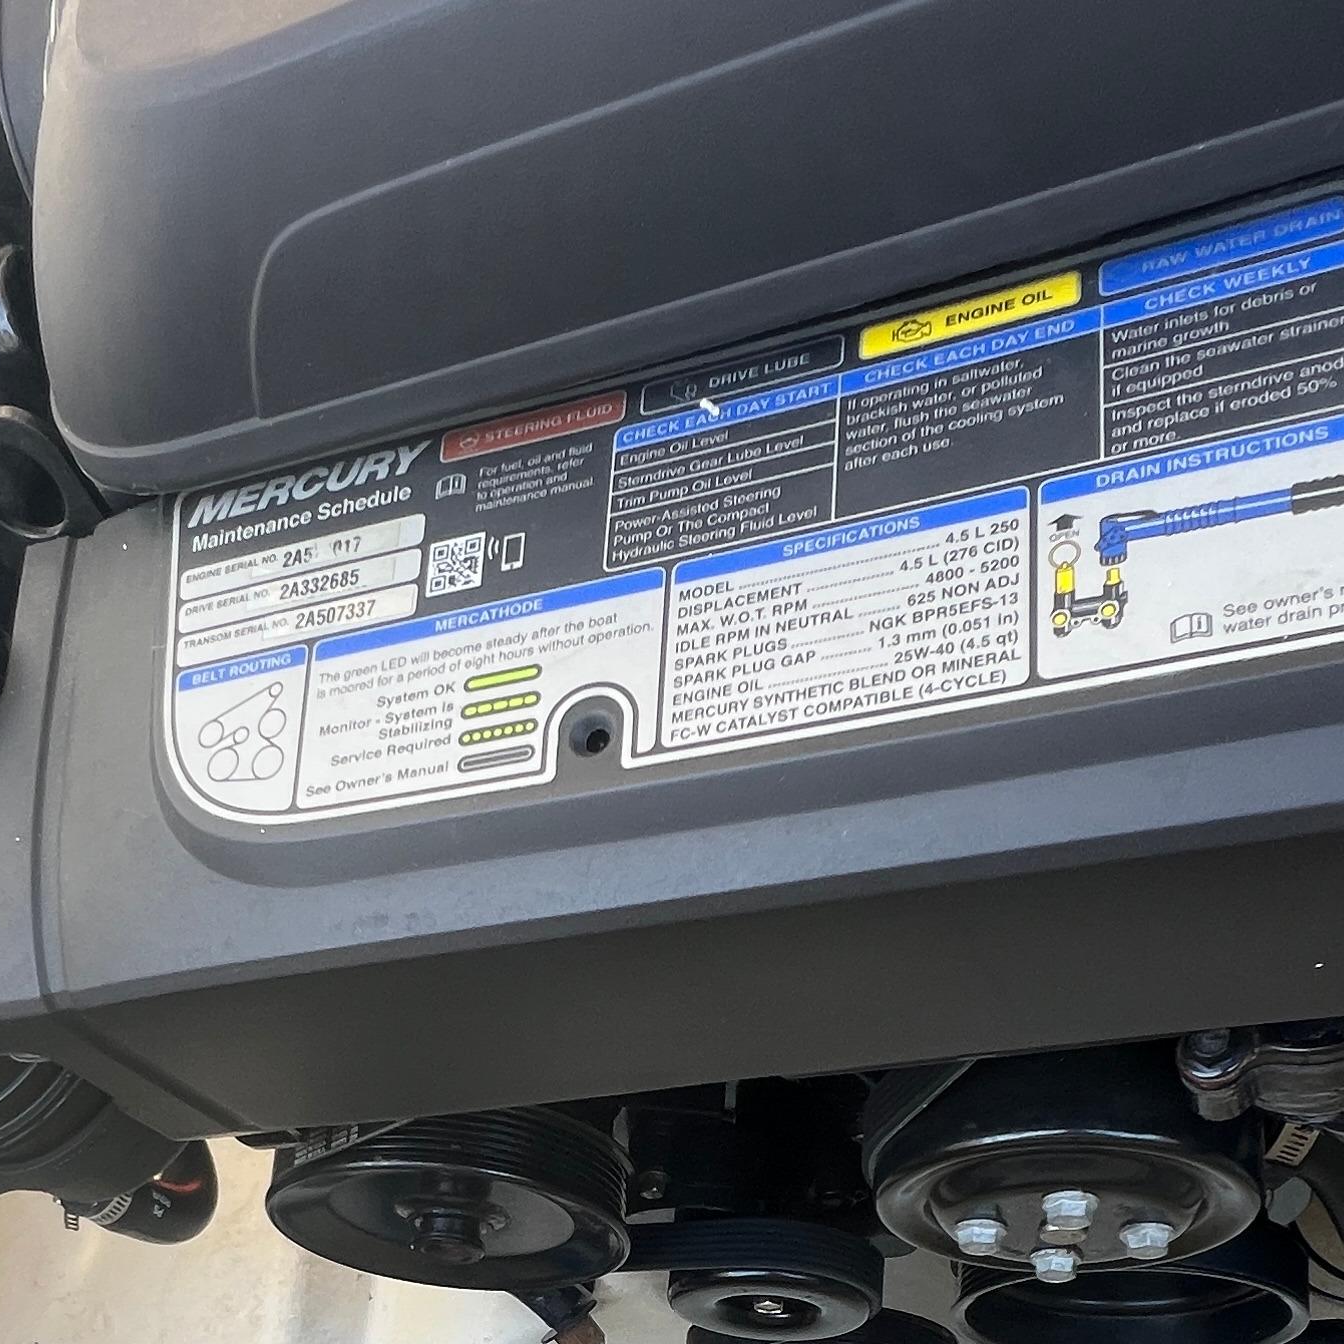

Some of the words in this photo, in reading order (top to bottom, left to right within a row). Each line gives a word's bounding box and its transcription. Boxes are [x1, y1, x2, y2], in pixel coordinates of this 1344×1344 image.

[1195, 230, 1265, 257] WATER
[1273, 209, 1340, 236] DRAIN
[945, 297, 1015, 326] ENGINE
[1021, 289, 1052, 305] OIL
[1144, 282, 1215, 309] CHECK
[1223, 257, 1310, 289] WEEKLY
[1111, 322, 1159, 343] Water
[1164, 310, 1208, 329] inlets
[1241, 289, 1294, 310] debris
[1111, 337, 1167, 359] marine
[1171, 320, 1232, 350] growth
[708, 367, 758, 388] DRIVE
[765, 354, 808, 374] LUBE
[864, 357, 927, 383] CHECK
[934, 343, 985, 365] EACH
[991, 330, 1029, 351] DAY
[1034, 319, 1074, 339] END
[1111, 361, 1160, 380] Clean
[1196, 332, 1274, 361] seawater
[1279, 315, 1344, 340] strainer
[846, 401, 907, 425] brackish
[912, 391, 956, 409] water,
[981, 365, 1042, 395] polluted
[860, 382, 929, 408] operating
[952, 358, 1023, 384] saltwater,
[1112, 397, 1171, 421] Inspect
[1208, 371, 1294, 398] sterndrive
[1125, 364, 1203, 393] equipped
[1147, 407, 1209, 429] replace
[1229, 385, 1291, 410] eroded
[1297, 376, 1337, 395] 50%
[485, 416, 562, 443] STEERING
[566, 404, 612, 423] FLUID
[622, 419, 679, 443] CHECK
[685, 407, 730, 428] EACH
[736, 397, 770, 416] DAY
[775, 382, 831, 406] START
[845, 435, 897, 456] section
[948, 409, 1003, 430] cooling
[1008, 394, 1063, 416] system
[846, 422, 888, 440] water,
[962, 386, 1032, 412] seawater
[618, 465, 685, 488] Sterndrive
[766, 434, 803, 454] Level
[620, 447, 665, 466] Engine
[1096, 462, 1160, 487] DRAIN
[1167, 426, 1328, 472] INSTRUCTIONS
[1133, 431, 1180, 449] more.
[187, 441, 429, 528] MERCURY
[614, 498, 718, 532] Power-Assisted
[723, 486, 780, 508] Steering
[648, 485, 690, 507] Pump
[715, 468, 752, 487] Level
[192, 511, 311, 552] Maintenance
[317, 485, 411, 520] Schedule
[612, 540, 674, 563] Hydraulic
[678, 526, 735, 547] Steering
[778, 505, 817, 525] Level
[613, 530, 652, 546] Pump
[706, 502, 769, 525] Compact
[783, 516, 920, 556] SPECIFICATIONS
[184, 565, 223, 586] ENGINE
[261, 553, 276, 564] NO.
[253, 588, 268, 599] NO.
[279, 568, 360, 600] 2A332685
[677, 582, 802, 619] DISPLACEMENT
[899, 556, 923, 571] 4.5
[928, 554, 938, 566] L
[943, 545, 977, 565] (276
[983, 536, 1019, 554] CID)
[679, 580, 734, 601] MODEL
[945, 528, 969, 543] 4.5
[975, 526, 985, 538] L
[990, 518, 1019, 535] 250
[435, 598, 542, 632] MERCATHODE
[675, 635, 710, 653] IDLE
[715, 628, 749, 645] RPM
[754, 623, 770, 638] IN
[775, 607, 853, 633] NEUTRAL
[907, 590, 935, 606] 625
[941, 580, 979, 599] NON
[984, 572, 1019, 591] ADJ
[676, 618, 714, 636] MAX.
[720, 606, 764, 627] W.O.T.
[772, 598, 807, 616] RPM
[925, 566, 964, 583] 4800
[980, 554, 1019, 573] 5200
[1263, 586, 1334, 610] owner's
[184, 630, 231, 648] TRANSOM
[271, 617, 289, 629] NO.
[295, 599, 376, 629] 2A507337
[587, 622, 653, 644] operation.
[674, 649, 727, 671] SPARK
[732, 637, 787, 659] PLUGS
[869, 613, 906, 632] NGK
[912, 592, 1018, 623] BPR5EFS-13
[1222, 615, 1271, 634] water
[1277, 606, 1322, 624] drain
[192, 668, 226, 685] BELT
[229, 653, 291, 677] ROUTING
[672, 683, 731, 706] ENGINE
[737, 679, 763, 693] OIL
[894, 641, 954, 664] 25W-40
[960, 634, 990, 654] (4.5
[996, 629, 1018, 646] qt)
[673, 667, 726, 688] SPARK
[731, 658, 775, 677] PLUG
[780, 650, 816, 667] GAP
[878, 633, 900, 648] 1.3
[906, 629, 936, 643] mm
[942, 615, 989, 639] (0.051
[997, 610, 1019, 625] in)
[376, 689, 428, 709] System
[433, 681, 455, 696] OK
[670, 723, 711, 741] FC-W
[715, 707, 798, 733] CATALYST
[803, 686, 913, 717] COMPATIBLE
[918, 669, 1006, 699] (4-CYCLE)
[671, 698, 748, 723] MERCURY
[753, 680, 843, 709] SYNTHETIC
[849, 669, 906, 690] BLEND
[911, 663, 936, 679] OR
[942, 648, 1021, 673] MINERAL
[319, 718, 371, 736] Monitor
[384, 705, 437, 725] System
[378, 717, 452, 740] Stabilizing
[330, 749, 382, 766] Service
[386, 733, 451, 756] Required
[335, 772, 392, 791] Owner's
[397, 760, 448, 779] Manual
